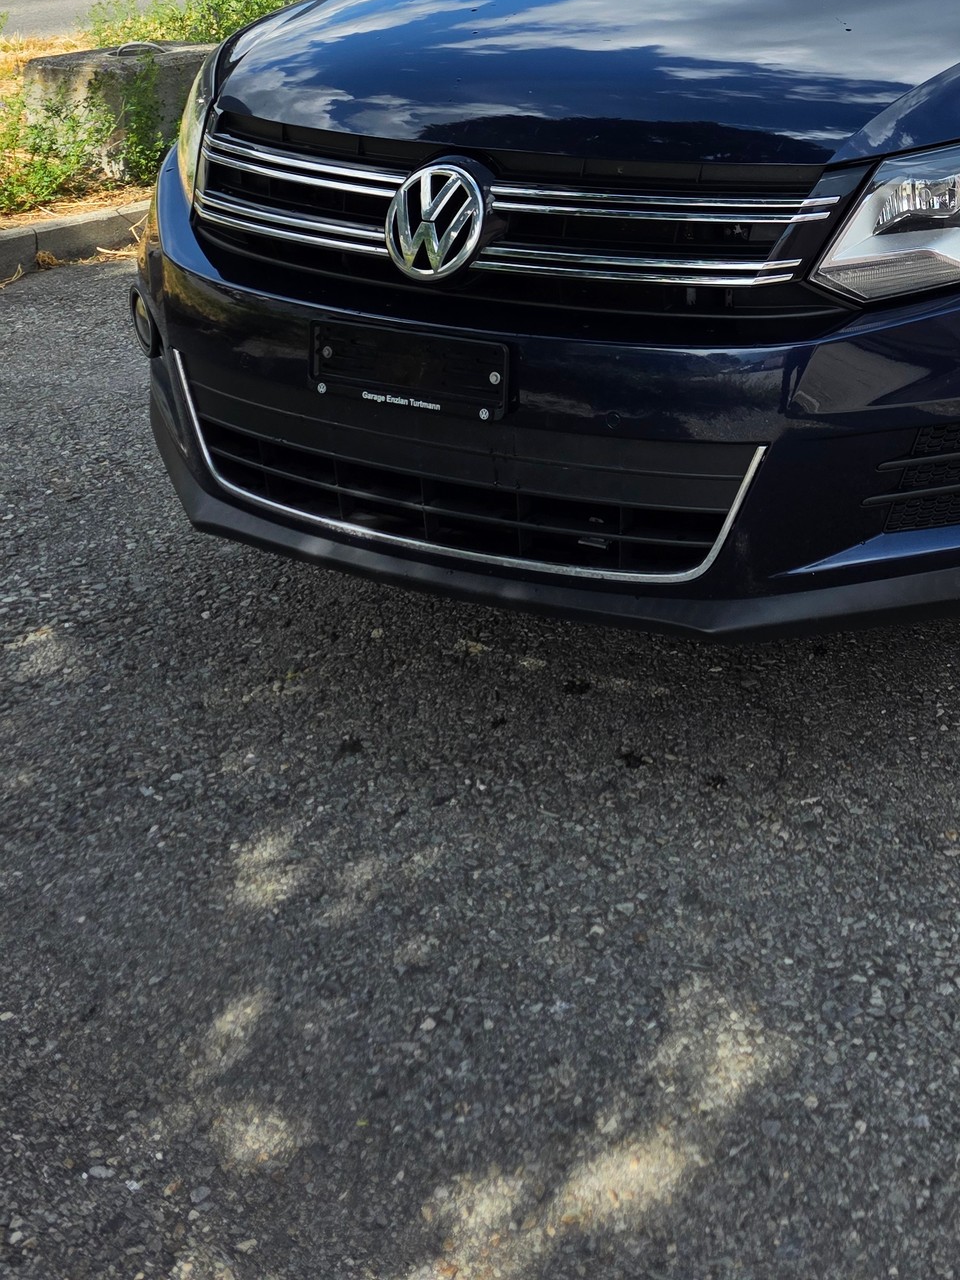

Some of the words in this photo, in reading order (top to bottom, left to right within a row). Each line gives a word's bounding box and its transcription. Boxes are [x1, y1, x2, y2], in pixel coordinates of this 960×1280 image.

[361, 391, 385, 403] Garage
[386, 394, 408, 406] Enzian
[409, 398, 441, 411] Turtmann
